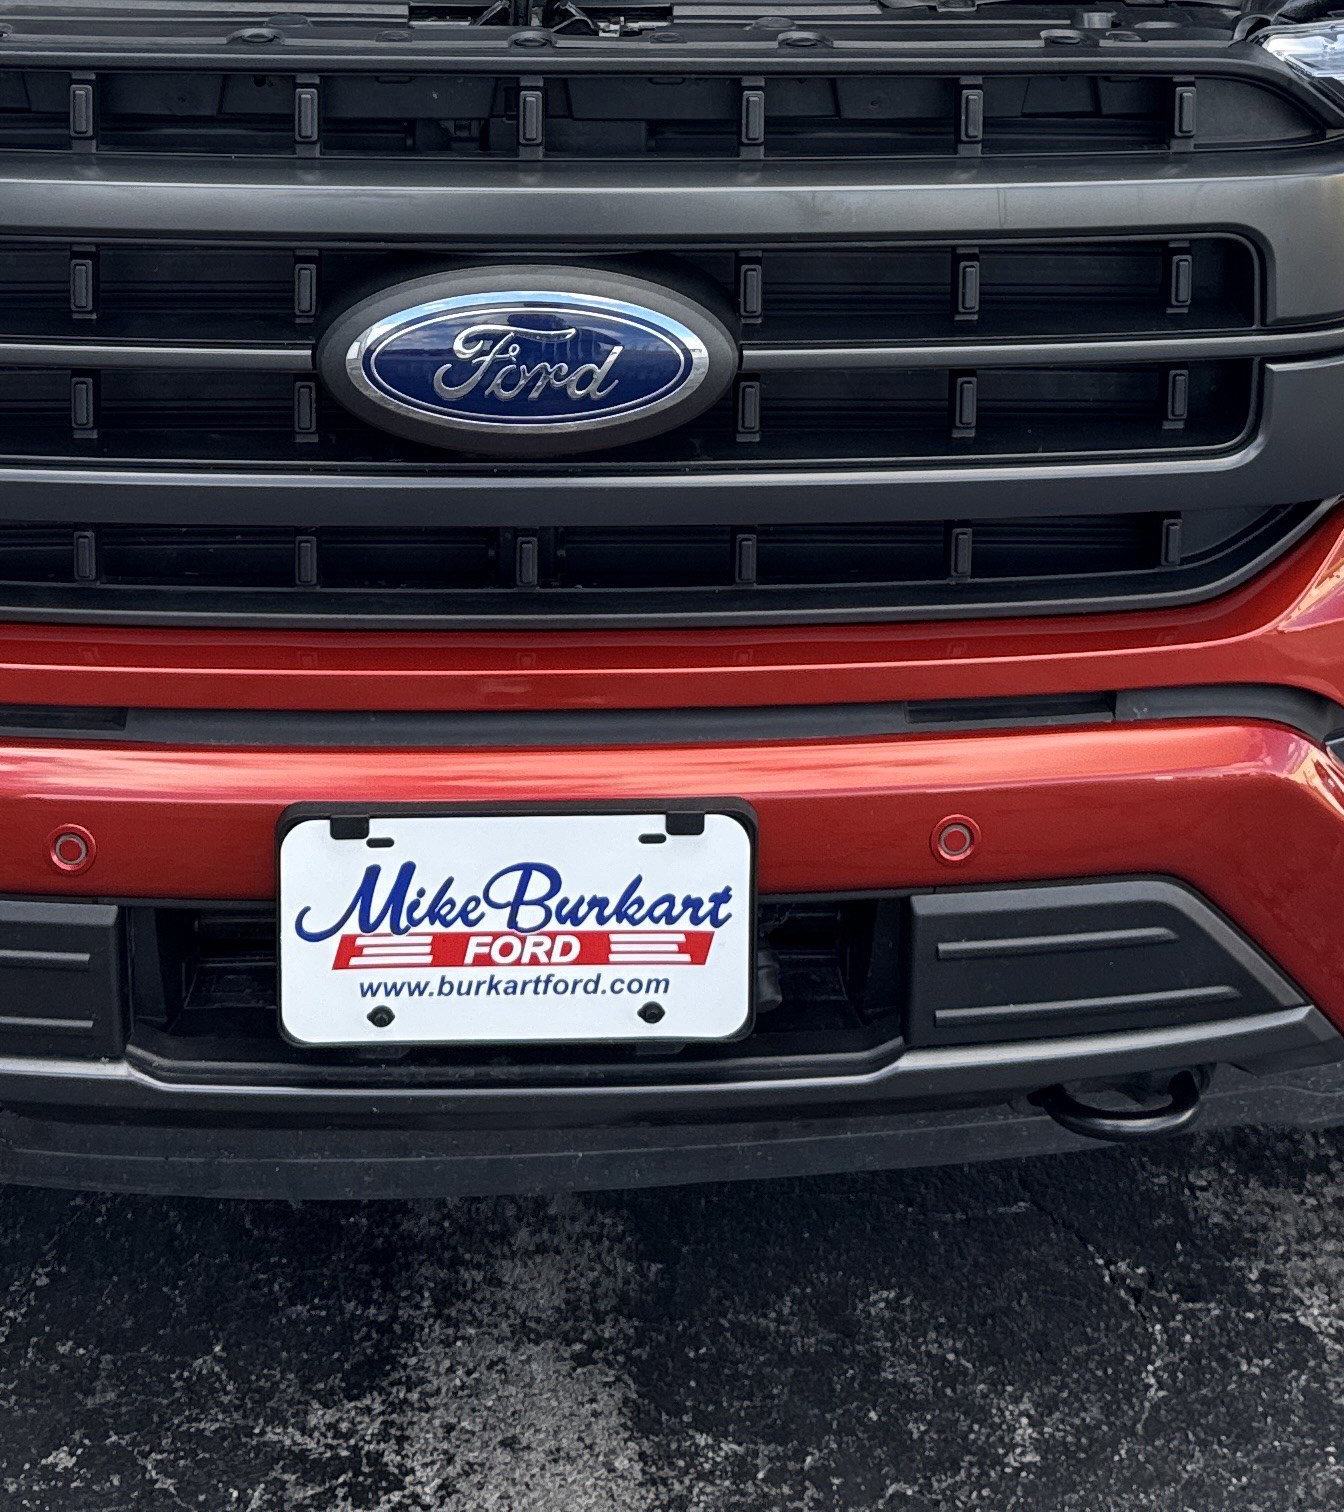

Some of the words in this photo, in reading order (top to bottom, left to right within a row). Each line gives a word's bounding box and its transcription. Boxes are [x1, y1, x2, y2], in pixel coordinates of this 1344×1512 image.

[433, 323, 624, 401] Ford
[294, 860, 486, 943] Mike
[482, 861, 733, 934] Burkart
[463, 934, 582, 966] FORD
[359, 973, 670, 998] www.burkartford.com
